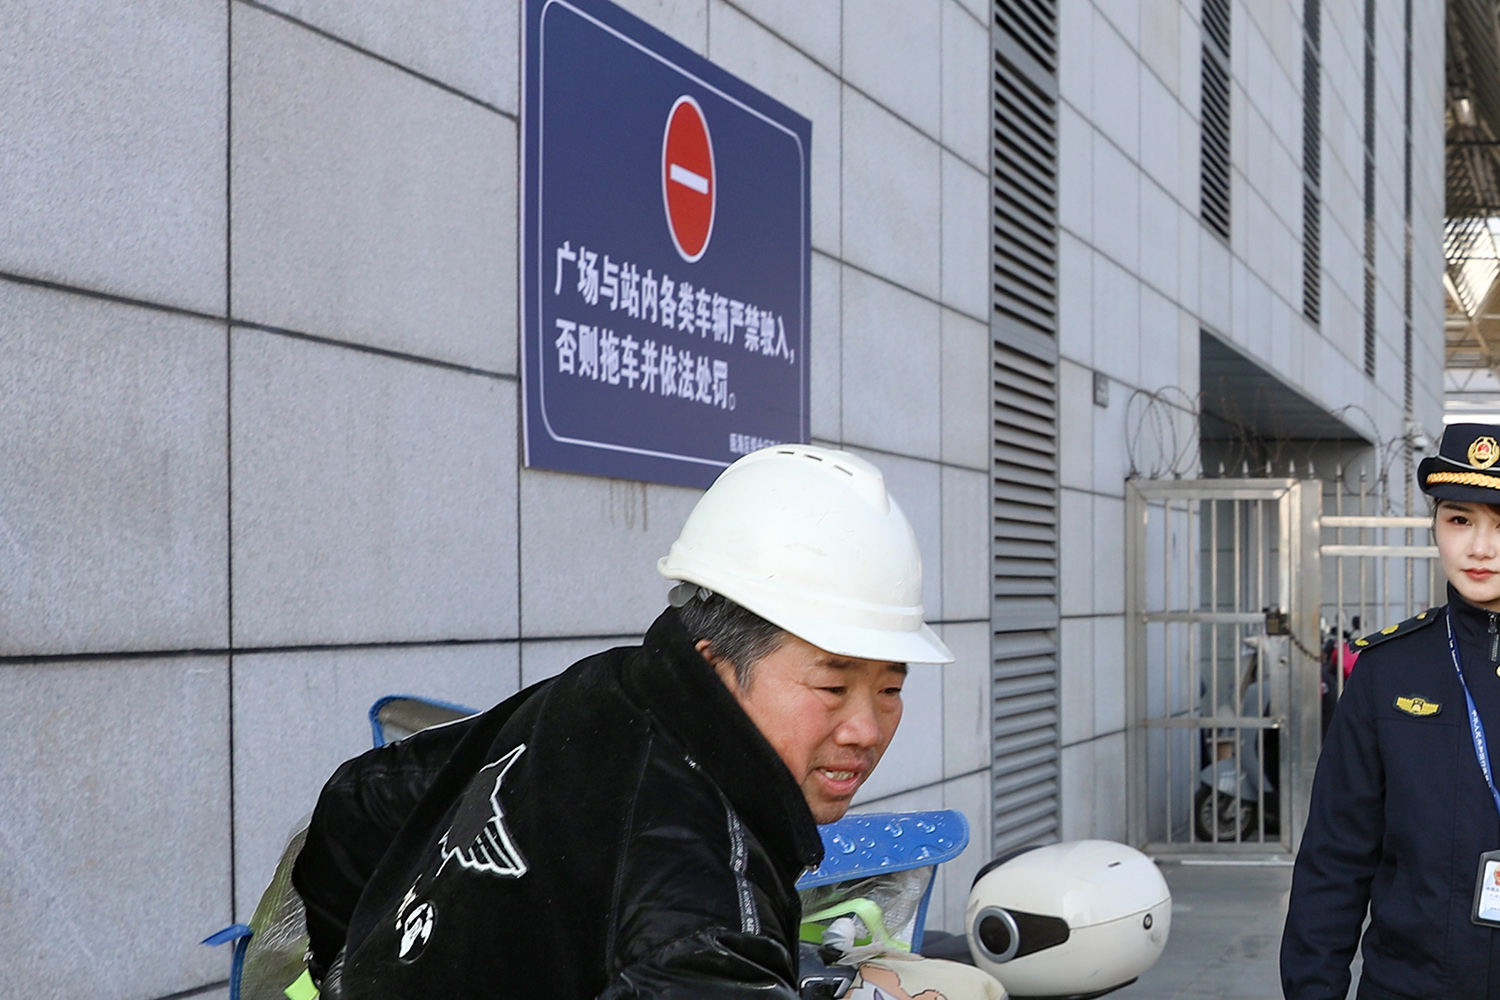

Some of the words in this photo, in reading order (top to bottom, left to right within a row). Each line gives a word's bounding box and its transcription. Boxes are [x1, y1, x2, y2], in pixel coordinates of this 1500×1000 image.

[554, 317, 737, 411] 否则拖车并依法处罚。
